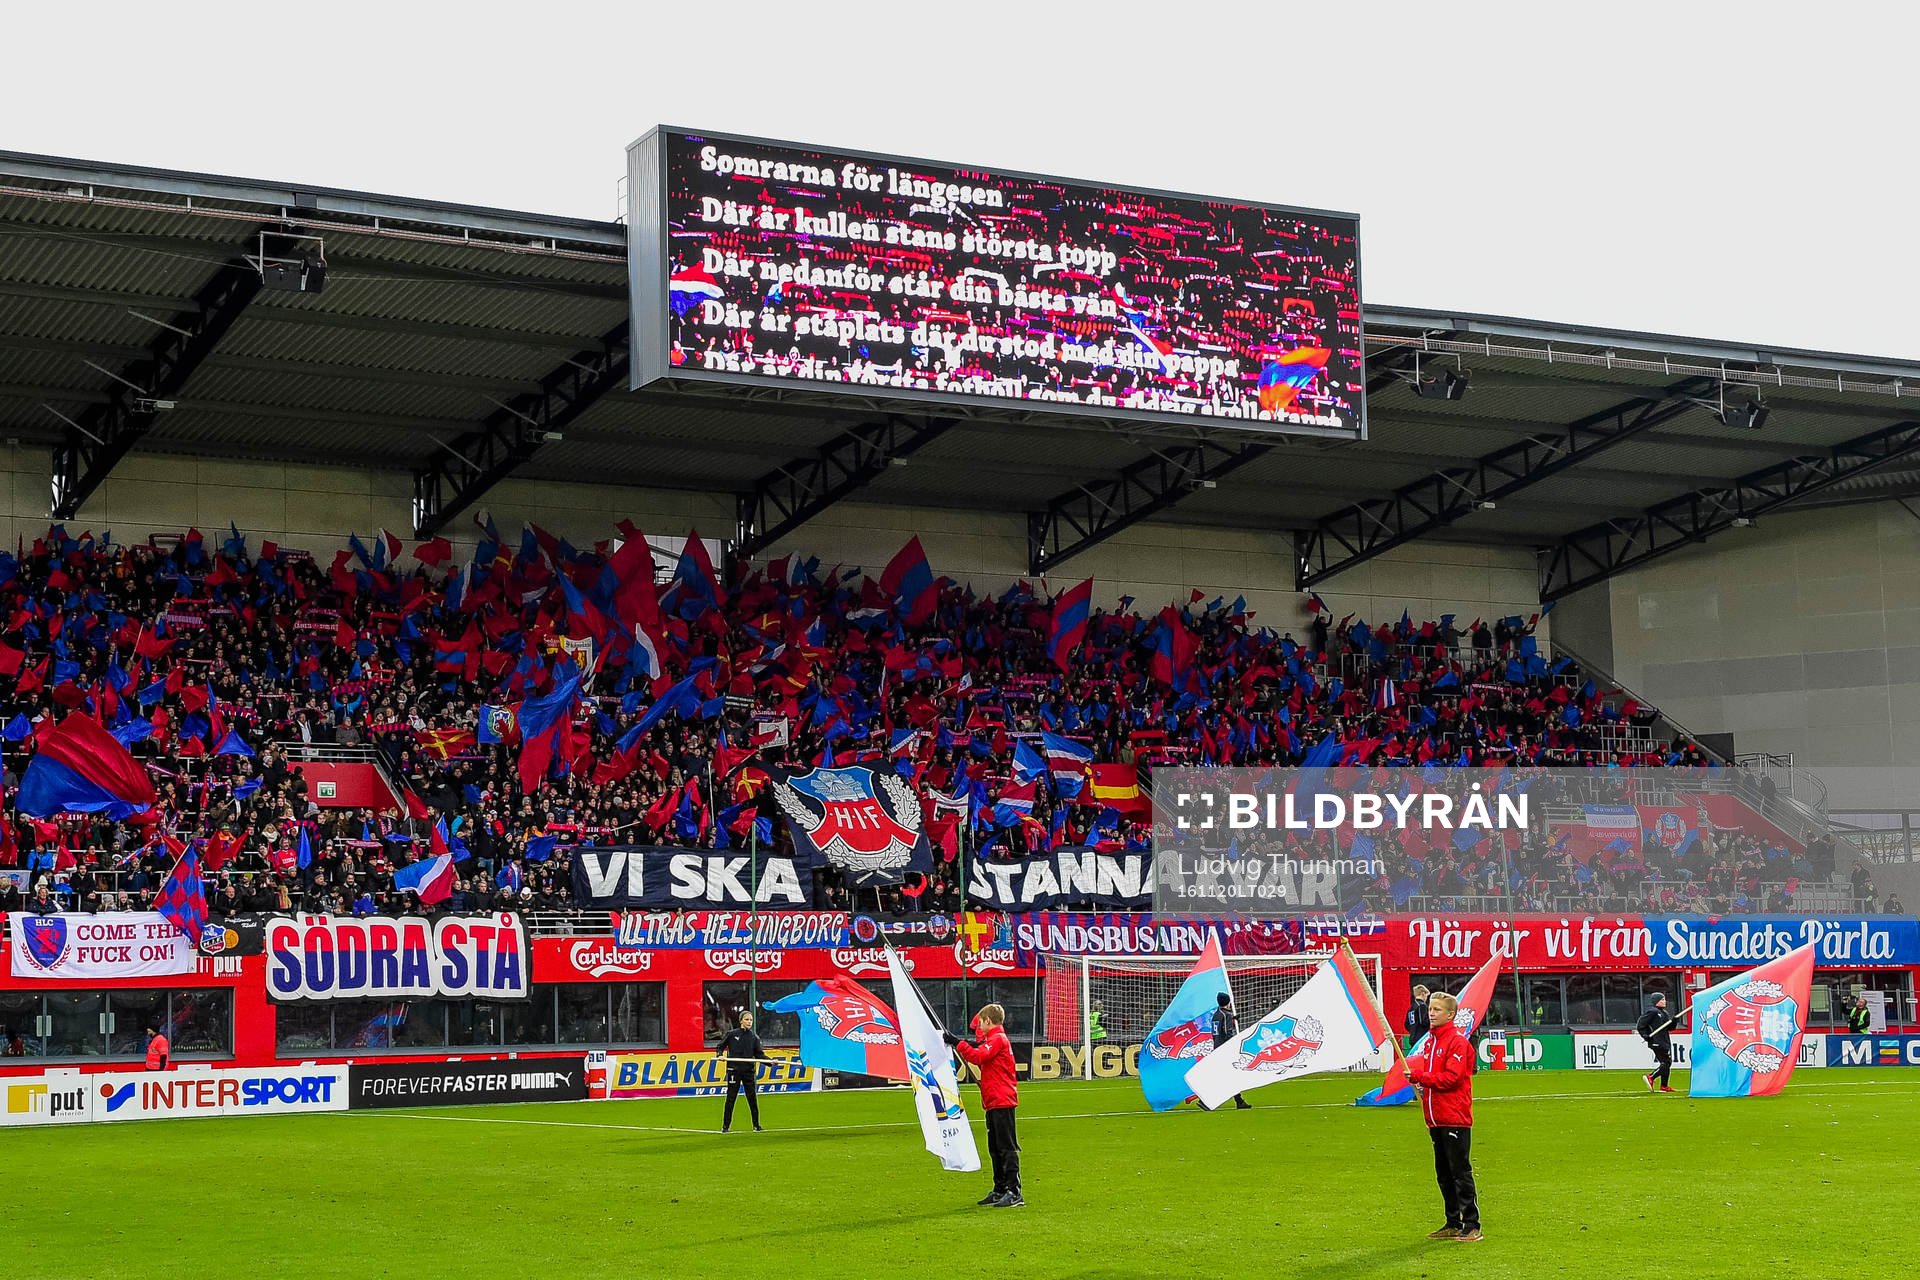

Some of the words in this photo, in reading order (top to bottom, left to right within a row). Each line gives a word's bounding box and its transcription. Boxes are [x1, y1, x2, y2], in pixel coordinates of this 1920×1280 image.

[700, 145, 837, 187] Somrarna
[841, 162, 884, 193] för
[887, 168, 1004, 209] längesen
[701, 196, 754, 227] Där
[758, 204, 790, 231] är
[794, 206, 881, 242] kullen
[885, 222, 957, 251] stans
[961, 230, 1054, 263] största
[1057, 241, 1118, 277] topp
[702, 247, 755, 278] Där
[759, 258, 885, 292] nedanför
[889, 271, 945, 299] står
[949, 274, 993, 304] din
[997, 282, 1067, 313] bästa
[1071, 292, 1118, 318] vän
[702, 299, 755, 329] Där
[760, 306, 792, 332] är
[797, 311, 905, 347] ståplats
[911, 321, 956, 350] där
[998, 333, 1057, 360] stod
[1060, 339, 1116, 365] med
[1117, 341, 1161, 371] din
[1165, 353, 1240, 383] pappa
[581, 851, 645, 898] VI
[670, 855, 807, 903] SKA
[968, 850, 1180, 900] STANNA
[35, 918, 54, 927] HLC
[76, 924, 137, 942] COME
[146, 923, 183, 940] THE
[618, 912, 699, 946] ULTRAS
[701, 912, 844, 948] HELSINGBORG
[911, 921, 927, 933] 12
[1408, 917, 1482, 958] Här
[1489, 920, 1530, 959] är
[1544, 918, 1577, 958] vi
[1579, 916, 1657, 963] från
[1666, 918, 1793, 961] Sundets
[1799, 918, 1896, 960] Pärla
[76, 944, 132, 963] FUCK
[139, 943, 175, 962] ON!
[272, 916, 431, 993] SÖDRA
[441, 912, 521, 990] STÅ
[570, 941, 653, 975] Carlsberg
[1583, 1045, 1598, 1065] HD
[142, 1075, 337, 1111] INTERSPORT
[511, 1072, 556, 1090] PUMA
